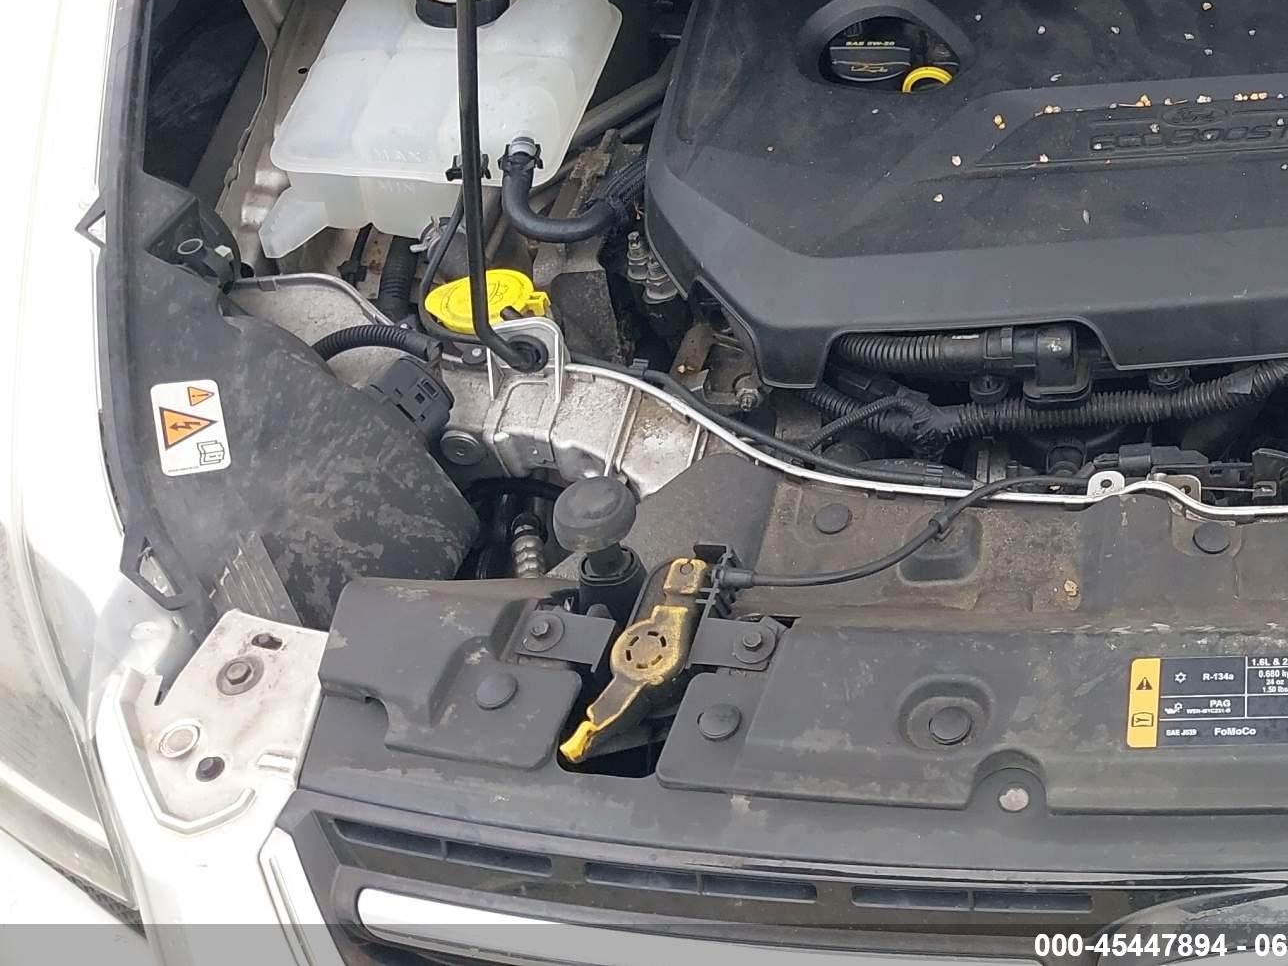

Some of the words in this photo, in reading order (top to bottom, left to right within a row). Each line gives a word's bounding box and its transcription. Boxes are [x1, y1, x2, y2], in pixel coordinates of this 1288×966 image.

[1251, 658, 1271, 666] 1.6L
[1273, 658, 1280, 666] &
[1202, 672, 1234, 681] R-134a
[1209, 699, 1231, 708] PAG
[1214, 727, 1257, 736] FoMoCo
